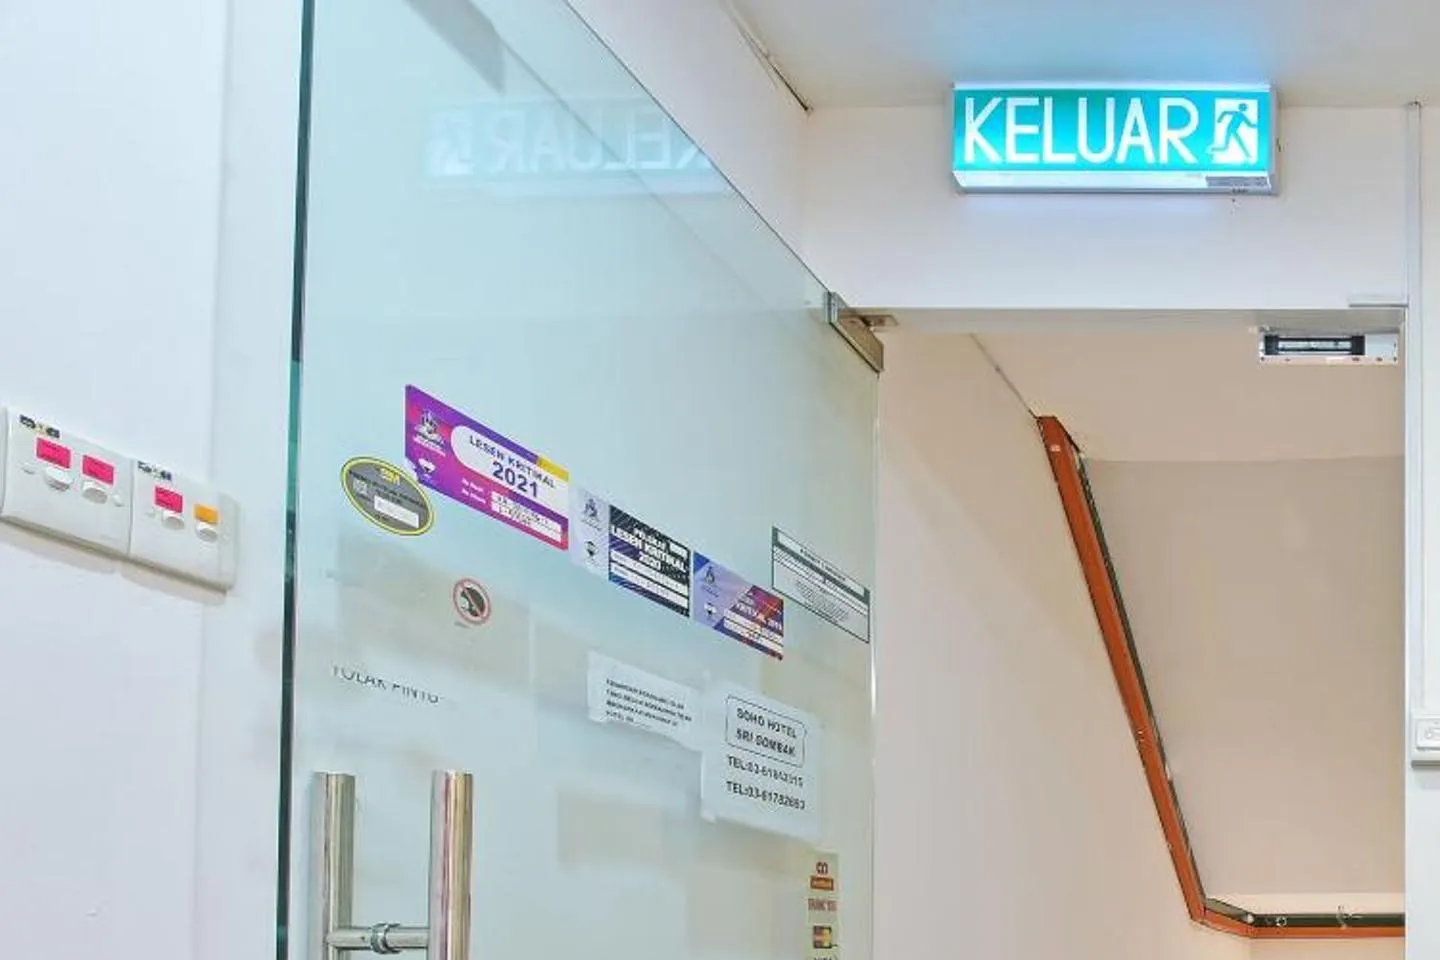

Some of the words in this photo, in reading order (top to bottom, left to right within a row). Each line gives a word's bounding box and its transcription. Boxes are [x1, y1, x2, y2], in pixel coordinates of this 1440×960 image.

[964, 97, 1200, 164] KELUAR
[469, 434, 504, 462] LESEN
[507, 456, 556, 489] KRITIKAL
[492, 461, 538, 498] 2021
[611, 523, 642, 549] LESEN
